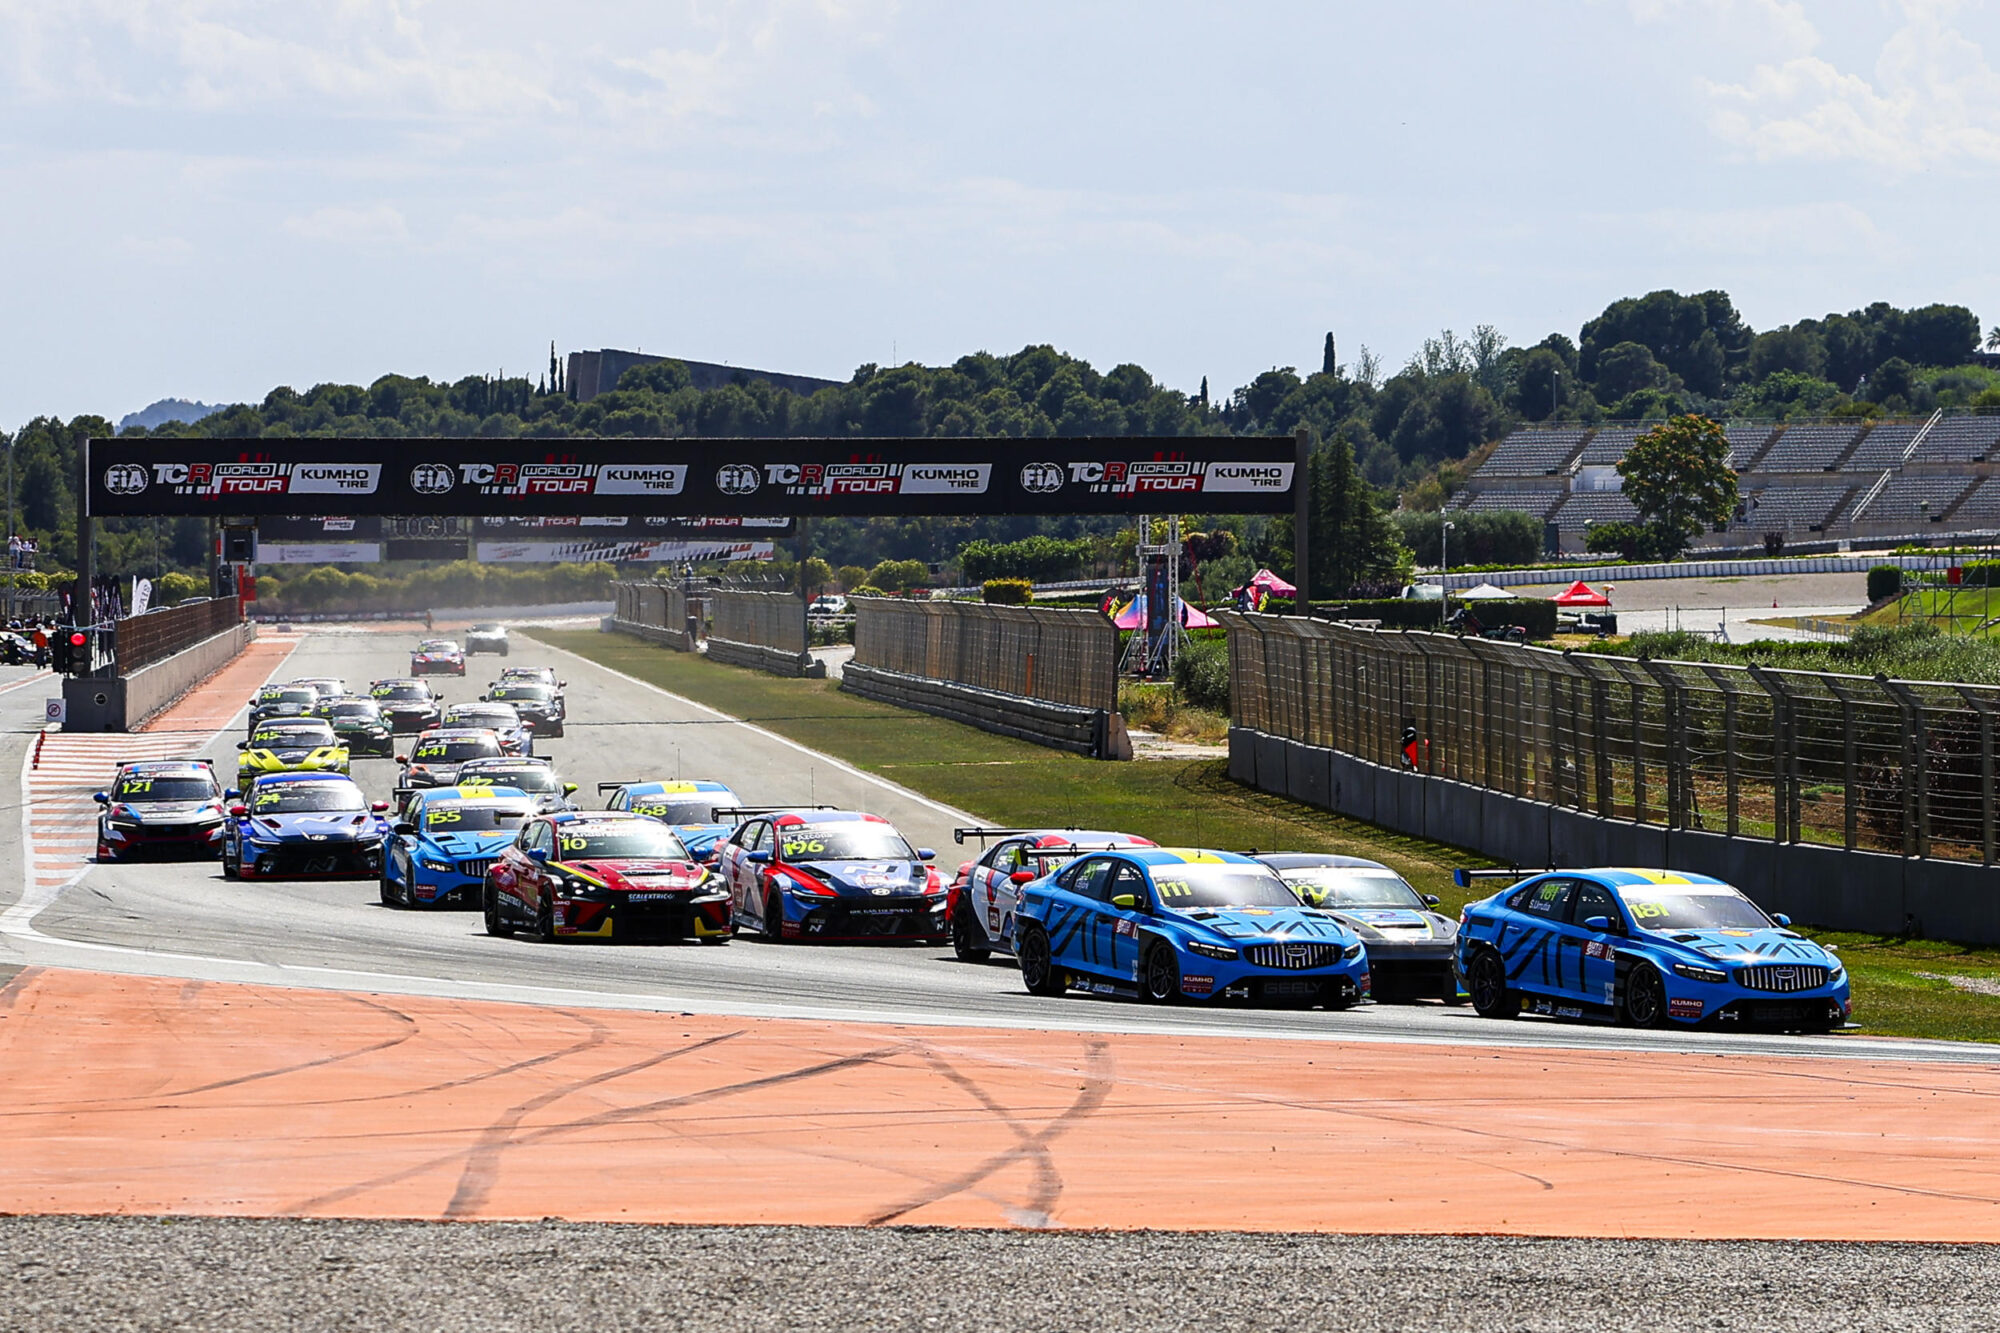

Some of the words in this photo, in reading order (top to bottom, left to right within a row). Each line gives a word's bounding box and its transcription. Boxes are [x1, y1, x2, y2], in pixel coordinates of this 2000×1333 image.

[152, 463, 212, 484] TCR
[218, 466, 270, 475] WORLD
[301, 469, 369, 480] KUMHO
[459, 463, 519, 484] TCR
[525, 467, 577, 475] WORLD
[764, 463, 824, 484] TCR
[830, 467, 881, 475] WORLD
[911, 469, 979, 480] KUMHO
[1068, 462, 1127, 482] TCR
[1133, 465, 1185, 473] WORLD
[1215, 468, 1282, 478] KUMHO
[606, 470, 674, 480] KUMHO
[225, 480, 282, 491] TOUR
[337, 480, 368, 488] TIRE
[532, 480, 588, 492] TOUR
[643, 481, 674, 489] TIRE
[837, 480, 893, 492] TOUR
[948, 480, 979, 488] TIRE
[1140, 478, 1196, 489] TOUR
[1250, 478, 1282, 486] TIRE
[547, 517, 577, 525] TOUR
[255, 731, 280, 741] 145
[417, 747, 447, 757] 441
[122, 782, 152, 793] 121
[426, 811, 462, 824] 155
[561, 838, 587, 850] 10
[782, 840, 825, 855] 196
[1157, 880, 1192, 898] 111
[1630, 902, 1670, 918] 181
[1264, 982, 1324, 994] GEELY
